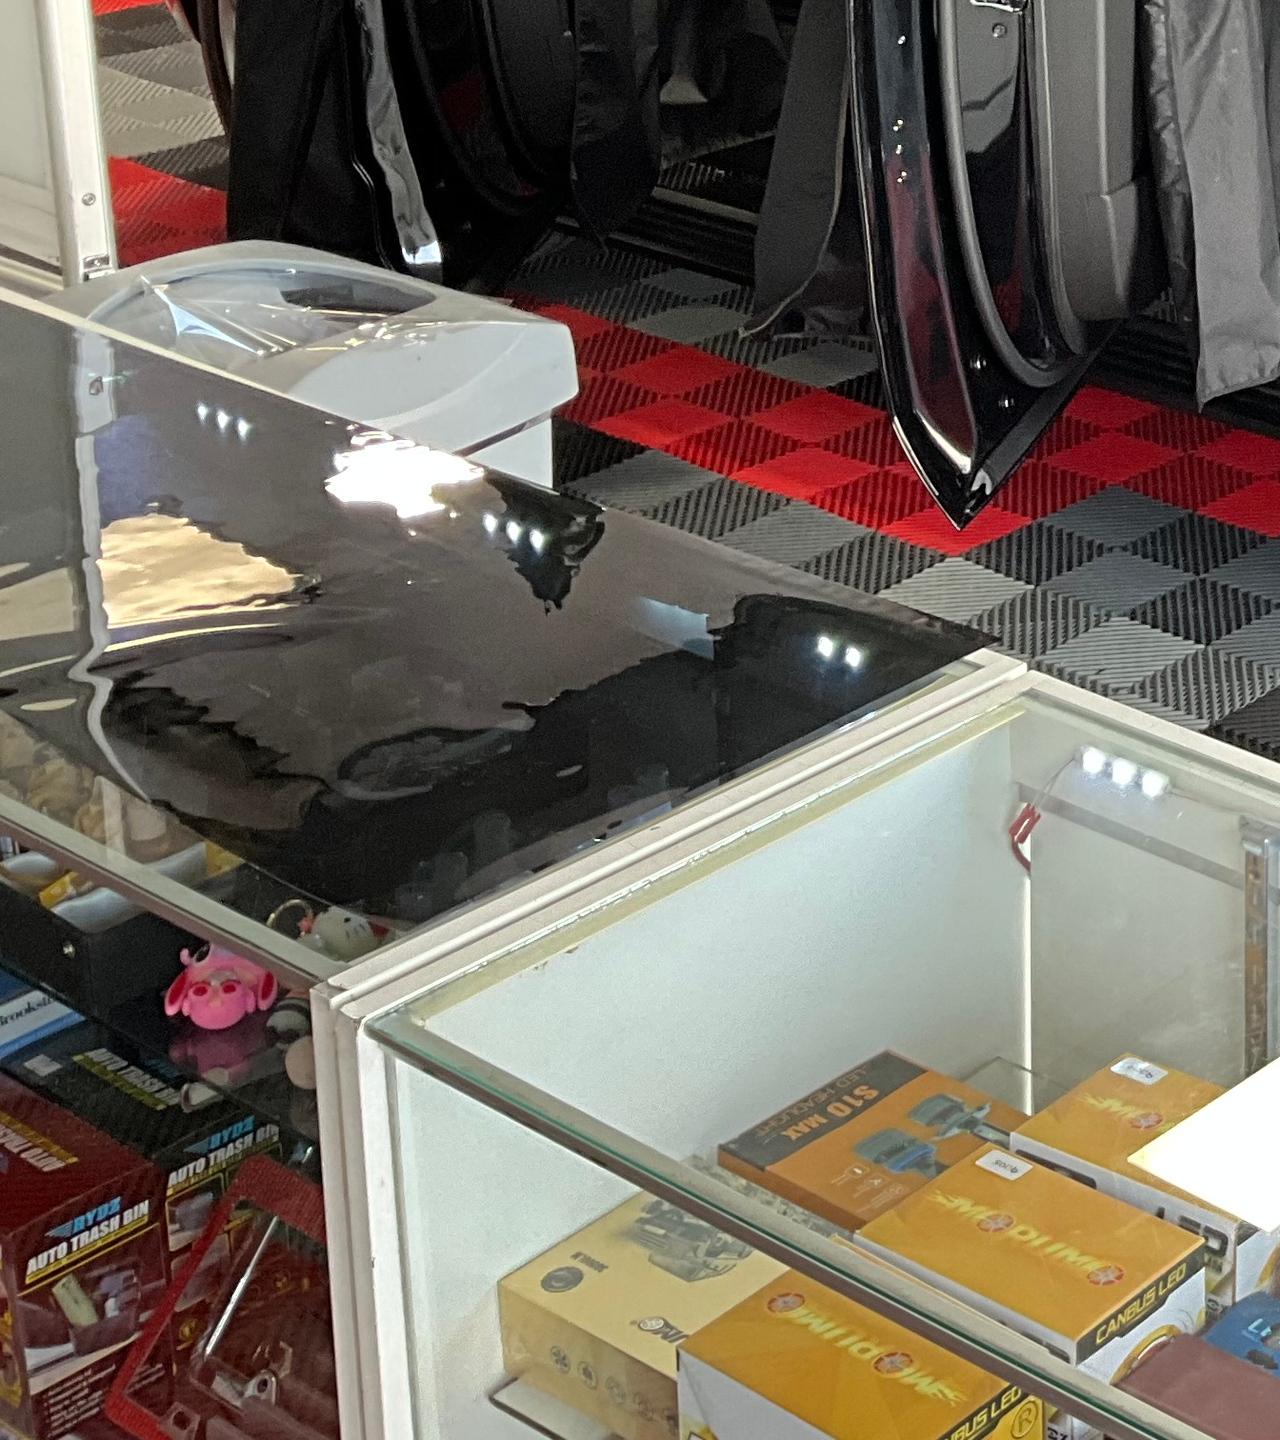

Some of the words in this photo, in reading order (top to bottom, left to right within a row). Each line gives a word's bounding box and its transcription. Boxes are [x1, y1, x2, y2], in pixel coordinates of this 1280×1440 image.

[826, 1084, 880, 1118] S10
[781, 1113, 829, 1141] MAX
[168, 1157, 206, 1188] AUTO
[207, 1132, 255, 1166] TRASH
[26, 1242, 68, 1275] AUTO
[70, 1213, 121, 1253] TRASH
[122, 1198, 150, 1227] BIN
[1095, 1288, 1156, 1346] CANBUS
[1157, 1262, 1187, 1296] LED
[990, 1385, 1022, 1419] LED
